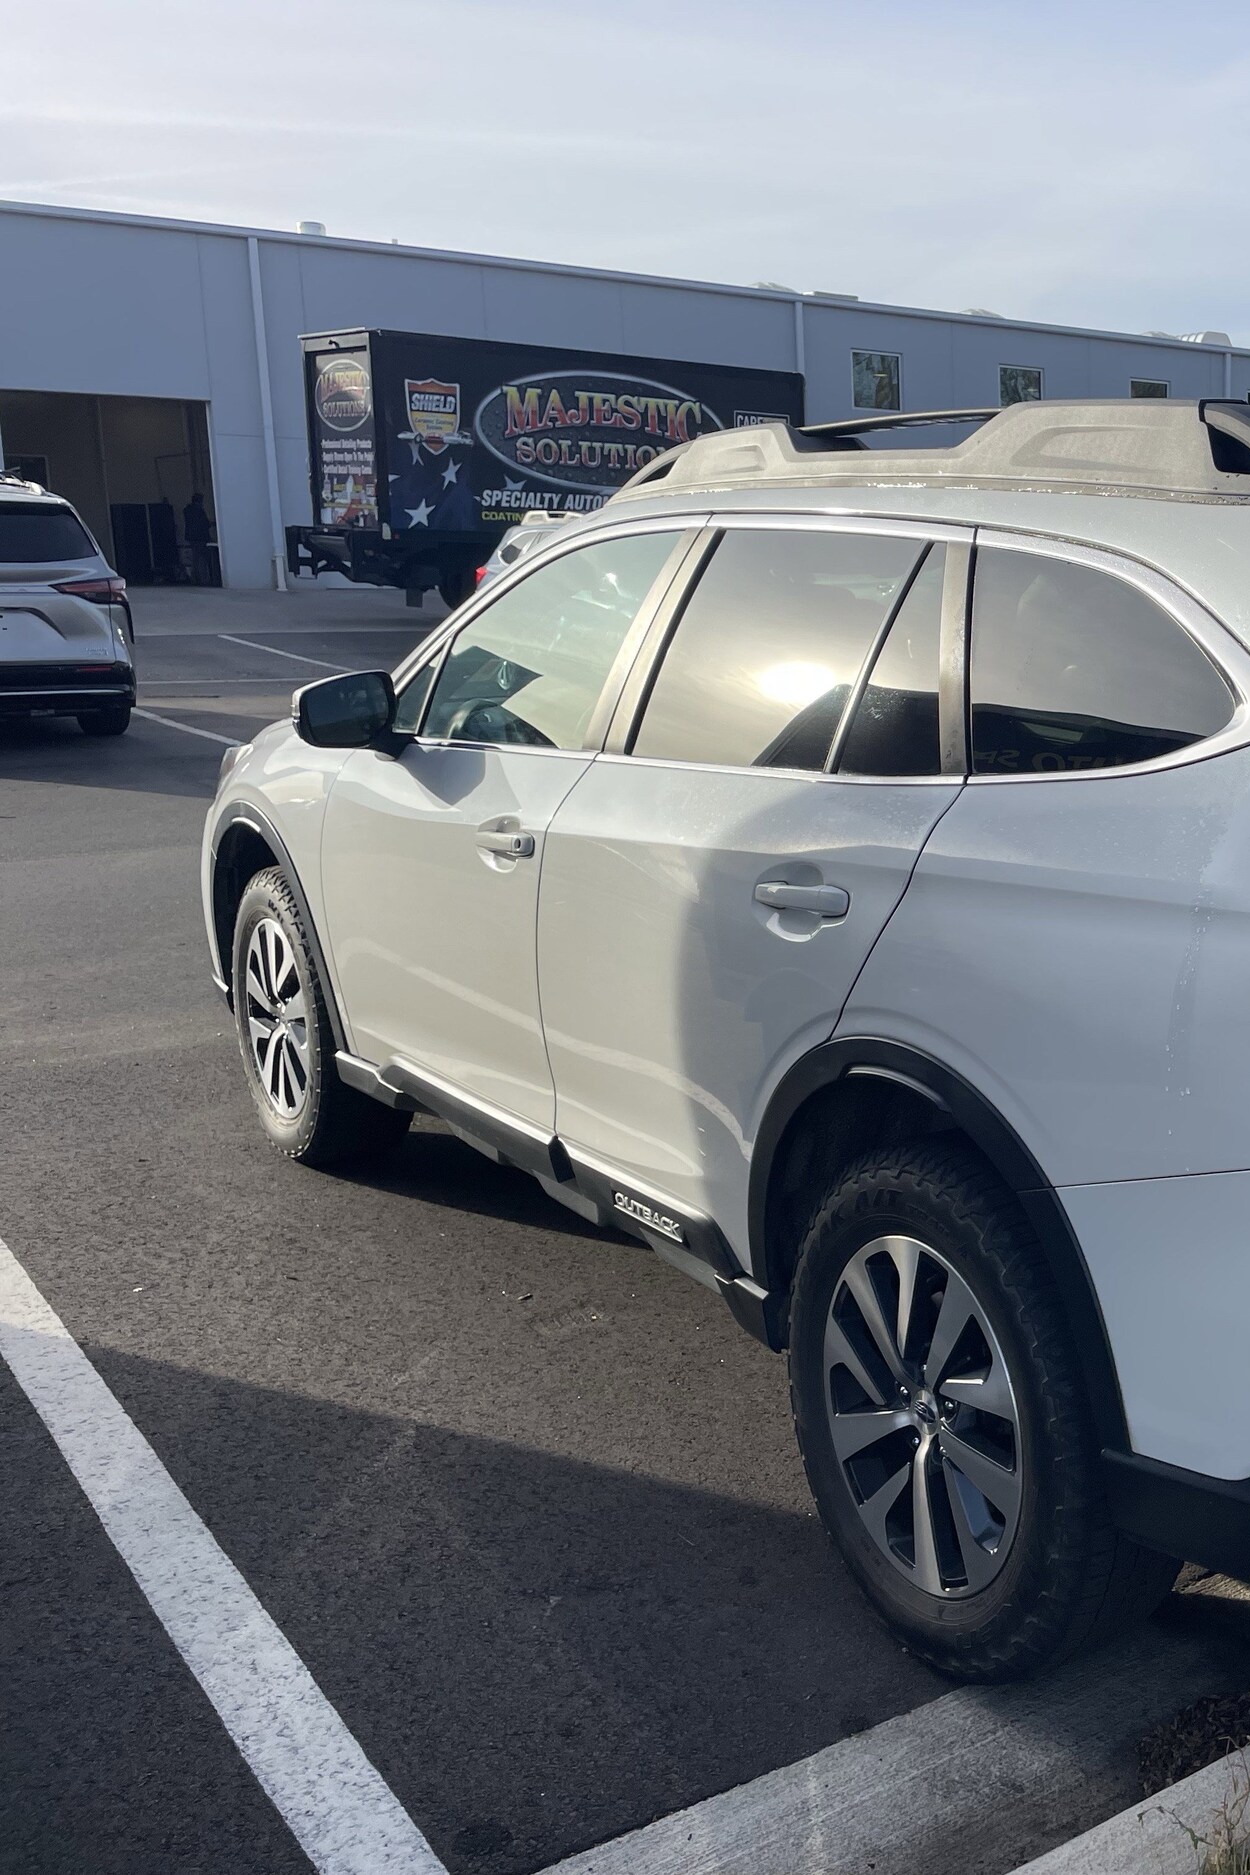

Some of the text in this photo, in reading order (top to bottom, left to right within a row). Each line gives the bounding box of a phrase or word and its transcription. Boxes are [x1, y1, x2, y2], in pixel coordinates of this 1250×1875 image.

[411, 393, 456, 413] SHIELD
[501, 385, 703, 443] MAJESTIC
[515, 436, 666, 470] SOLUTIO
[481, 489, 562, 510] SPECIALTY
[481, 511, 524, 522] COATIN
[614, 1192, 680, 1238] OUTBACK
